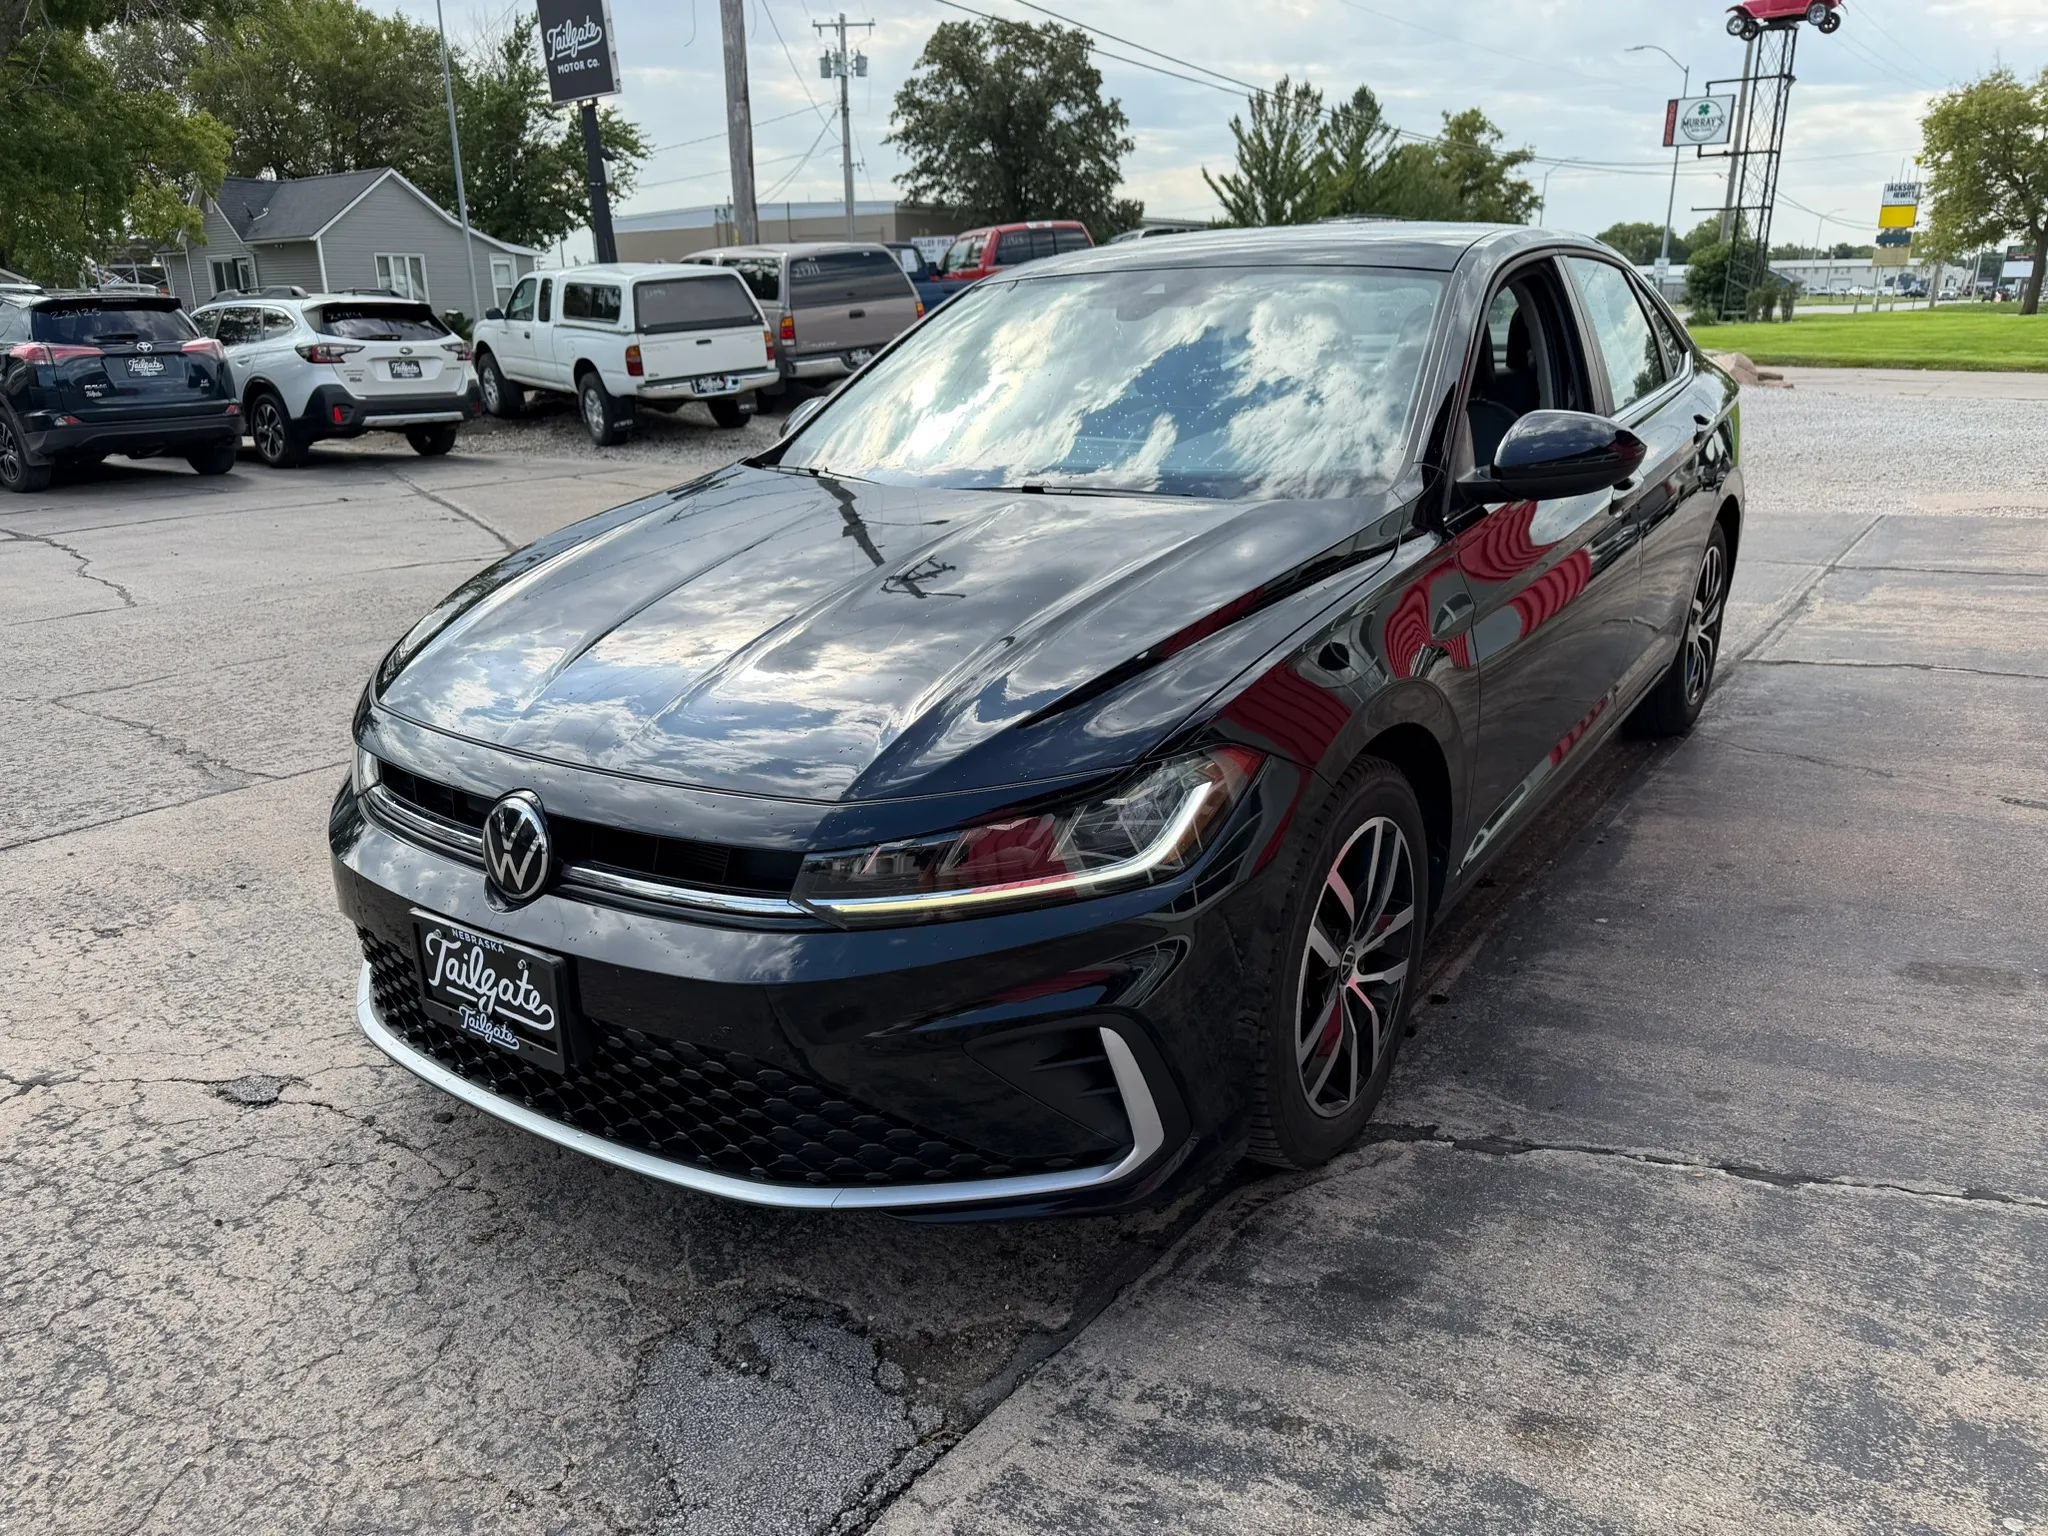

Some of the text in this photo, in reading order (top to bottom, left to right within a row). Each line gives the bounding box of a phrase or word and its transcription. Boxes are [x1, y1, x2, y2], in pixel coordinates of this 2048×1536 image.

[547, 15, 602, 60] Tailgate
[558, 61, 585, 74] MOTOR
[1681, 115, 1725, 130] MURRAY'S
[1887, 184, 1916, 192] JACKSON
[451, 928, 504, 954] NEBRASKA
[425, 931, 555, 1031] Tailgate
[459, 1005, 520, 1050] Tailgate
